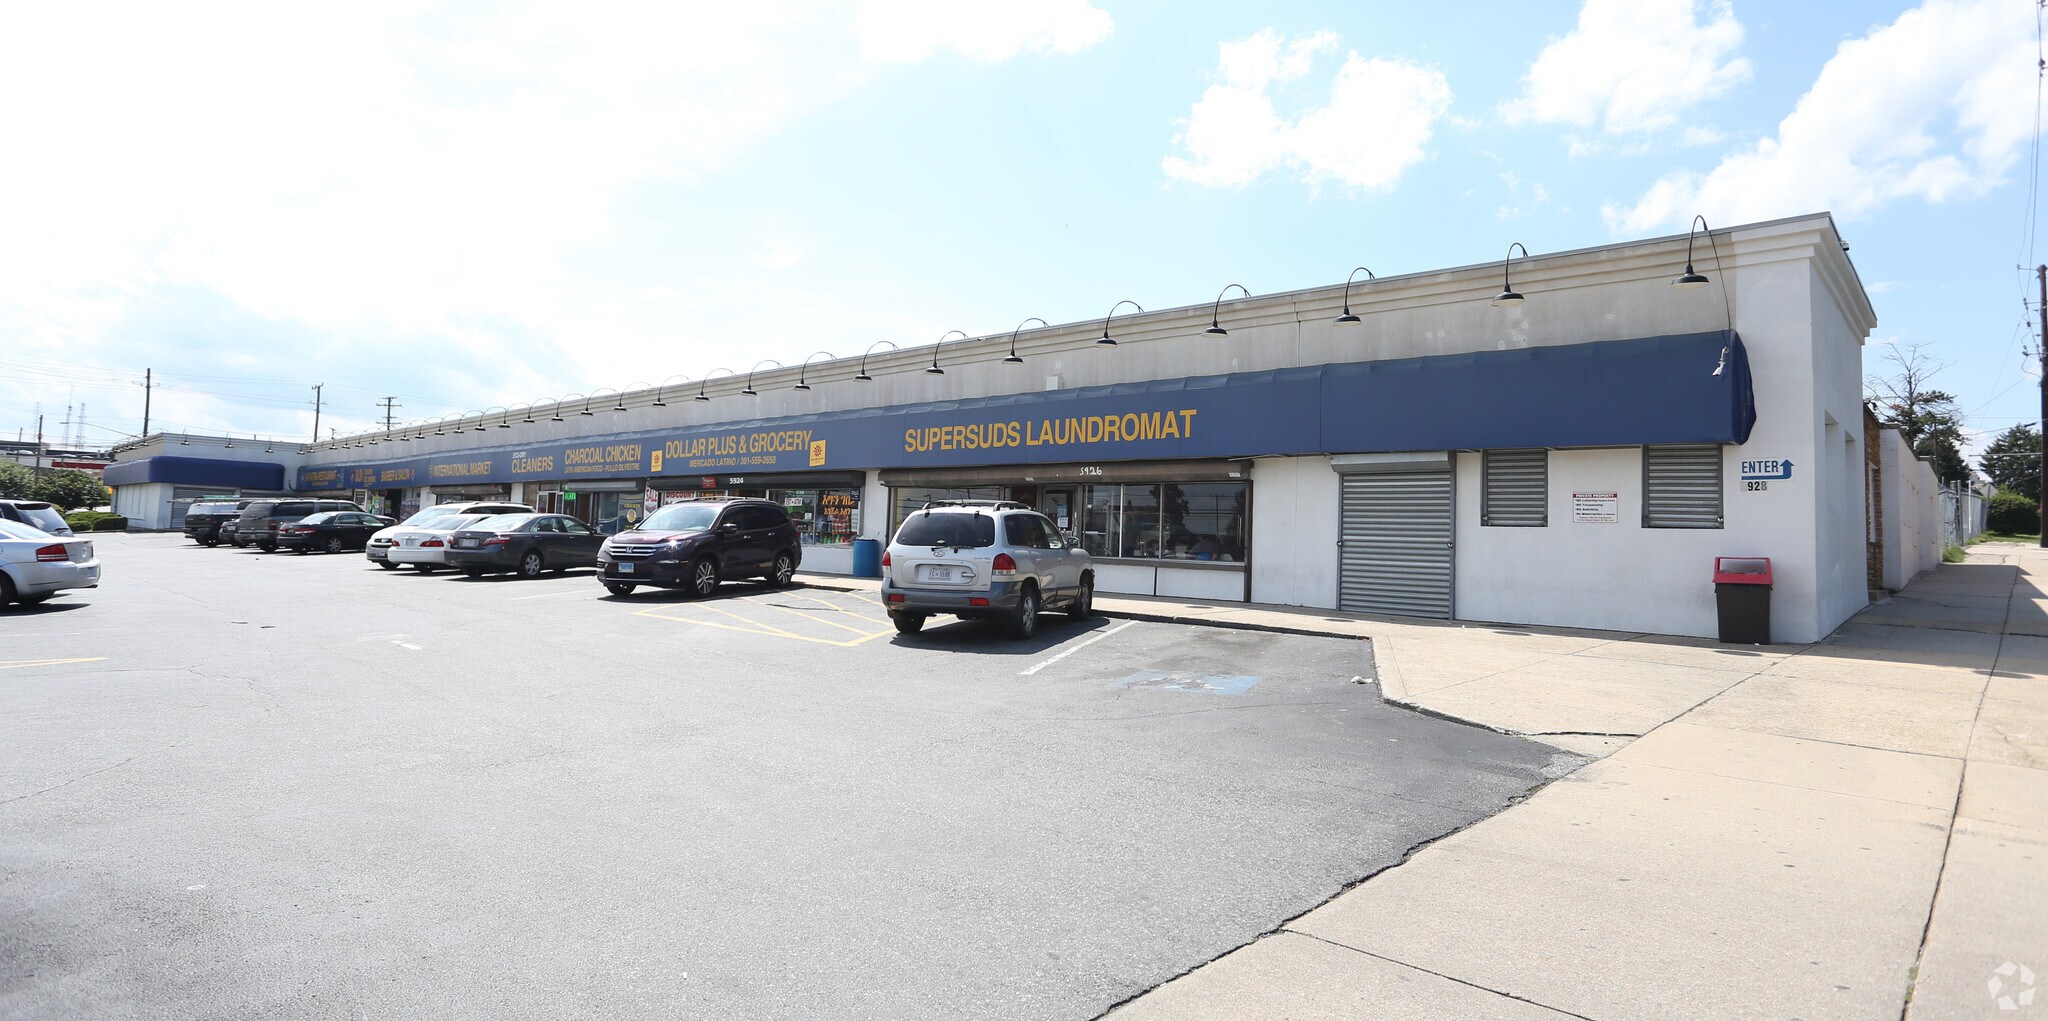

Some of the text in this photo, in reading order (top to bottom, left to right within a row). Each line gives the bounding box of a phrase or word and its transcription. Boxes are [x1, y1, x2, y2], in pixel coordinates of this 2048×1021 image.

[904, 409, 1198, 453] SUPERSUDS LAUNDROMAT
[665, 430, 813, 459] DOLLAR PLUS & GROCERY
[564, 444, 642, 465] CHARCOAL CHICKEN
[689, 457, 715, 468] MERCADO
[716, 456, 736, 467] LATINO
[433, 463, 469, 477] INTERNATIONAL
[469, 461, 492, 476] MARKET
[511, 456, 554, 473] CLEANERS
[1080, 466, 1102, 476] 5926
[1741, 460, 1779, 473] ENTER
[645, 487, 658, 501] SALE
[666, 490, 695, 499] DISCOUNT
